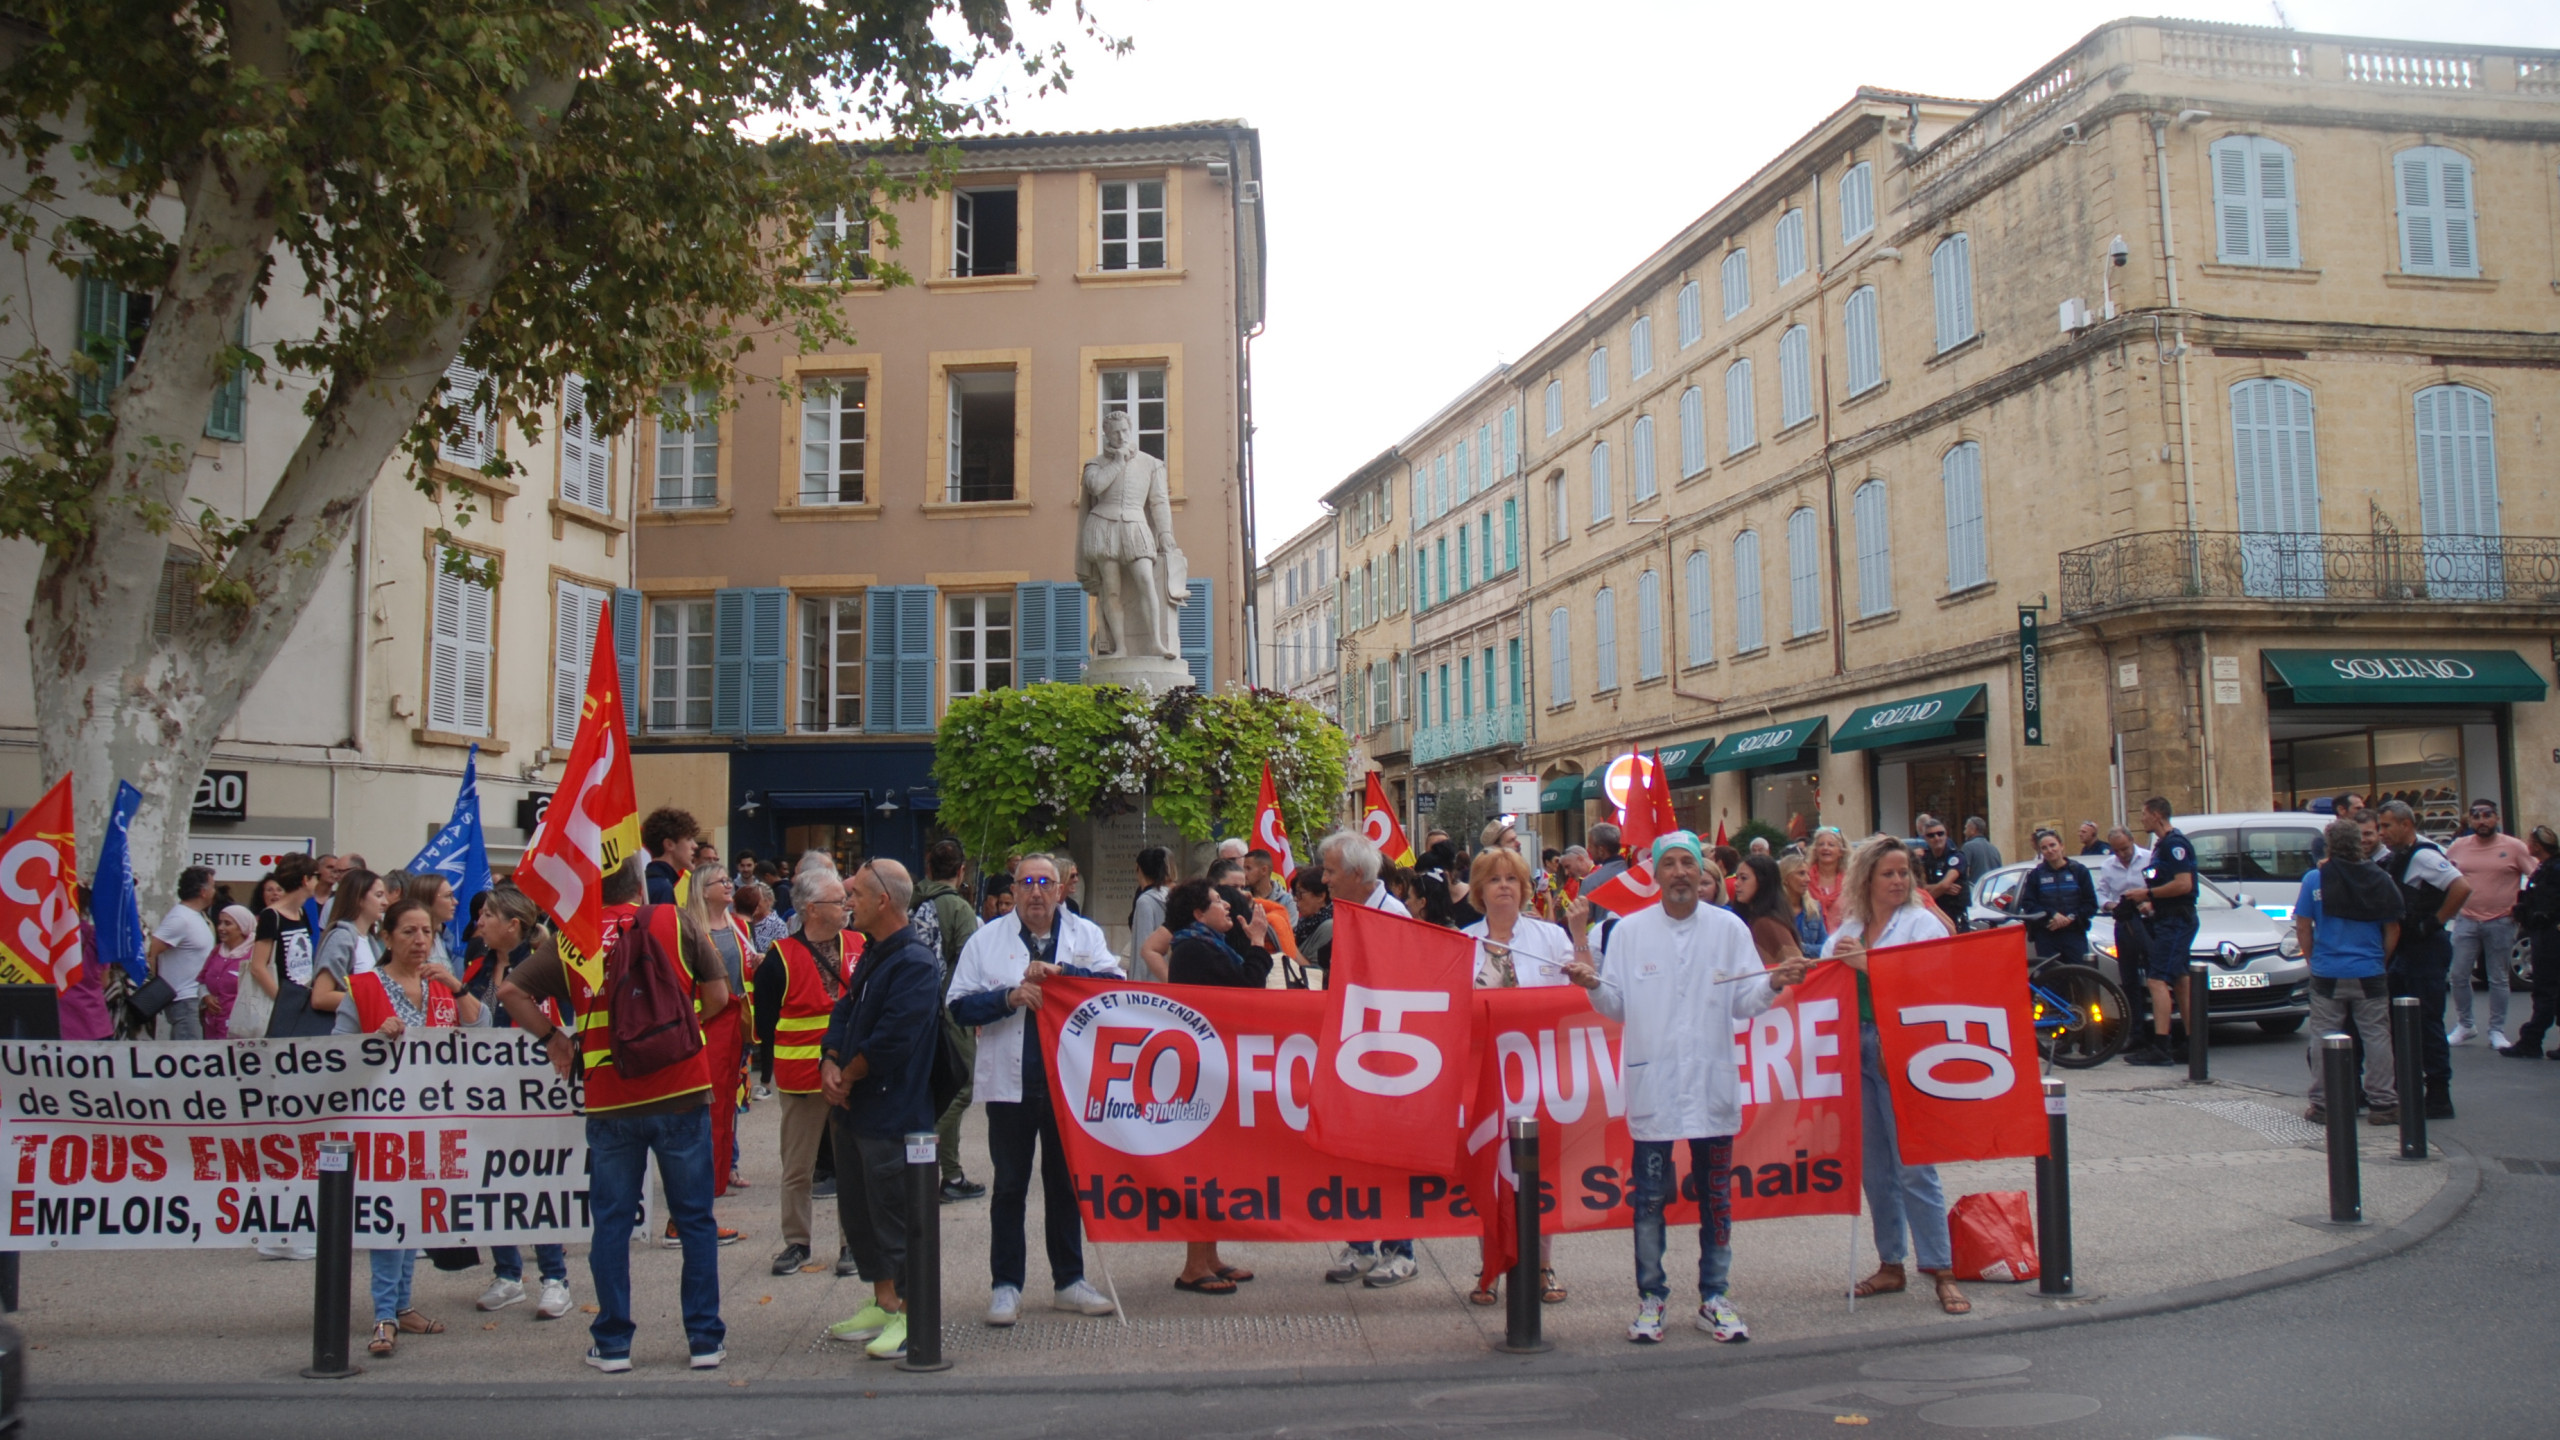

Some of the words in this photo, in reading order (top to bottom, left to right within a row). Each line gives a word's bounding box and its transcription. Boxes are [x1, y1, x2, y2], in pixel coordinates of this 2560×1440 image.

[2330, 658, 2475, 679] SOLEIADO
[193, 853, 251, 866] PETITE
[2211, 977, 2224, 988] EB
[2228, 976, 2246, 987] 260
[2250, 975, 2263, 986] EN
[1067, 1002, 1100, 1037] LIBRE
[1102, 994, 1119, 1010] ET
[1126, 993, 1215, 1041] INDEPENDANT
[3, 1045, 114, 1079] Union
[131, 1046, 261, 1079] Locale
[275, 1043, 346, 1075] des
[361, 1034, 552, 1074] Syndicats
[1084, 1026, 1200, 1123] FO
[1898, 1004, 2016, 1101] FO
[19, 1087, 59, 1116] de
[69, 1090, 171, 1120] Salon
[183, 1091, 227, 1120] de
[240, 1080, 405, 1118] Provence
[419, 1080, 454, 1112] et
[459, 1086, 506, 1112] sa
[1088, 1096, 1101, 1119] la
[1107, 1097, 1142, 1119] force
[1144, 1098, 1210, 1124] syndicale
[11, 1134, 167, 1185] TOUS
[482, 1148, 572, 1187] pour
[10, 1190, 201, 1243] EMPLOIS,
[216, 1187, 406, 1243] SALAES,
[1074, 1174, 1281, 1231] Hôpital
[1307, 1176, 1382, 1221] du
[1408, 1174, 1556, 1219] Pas
